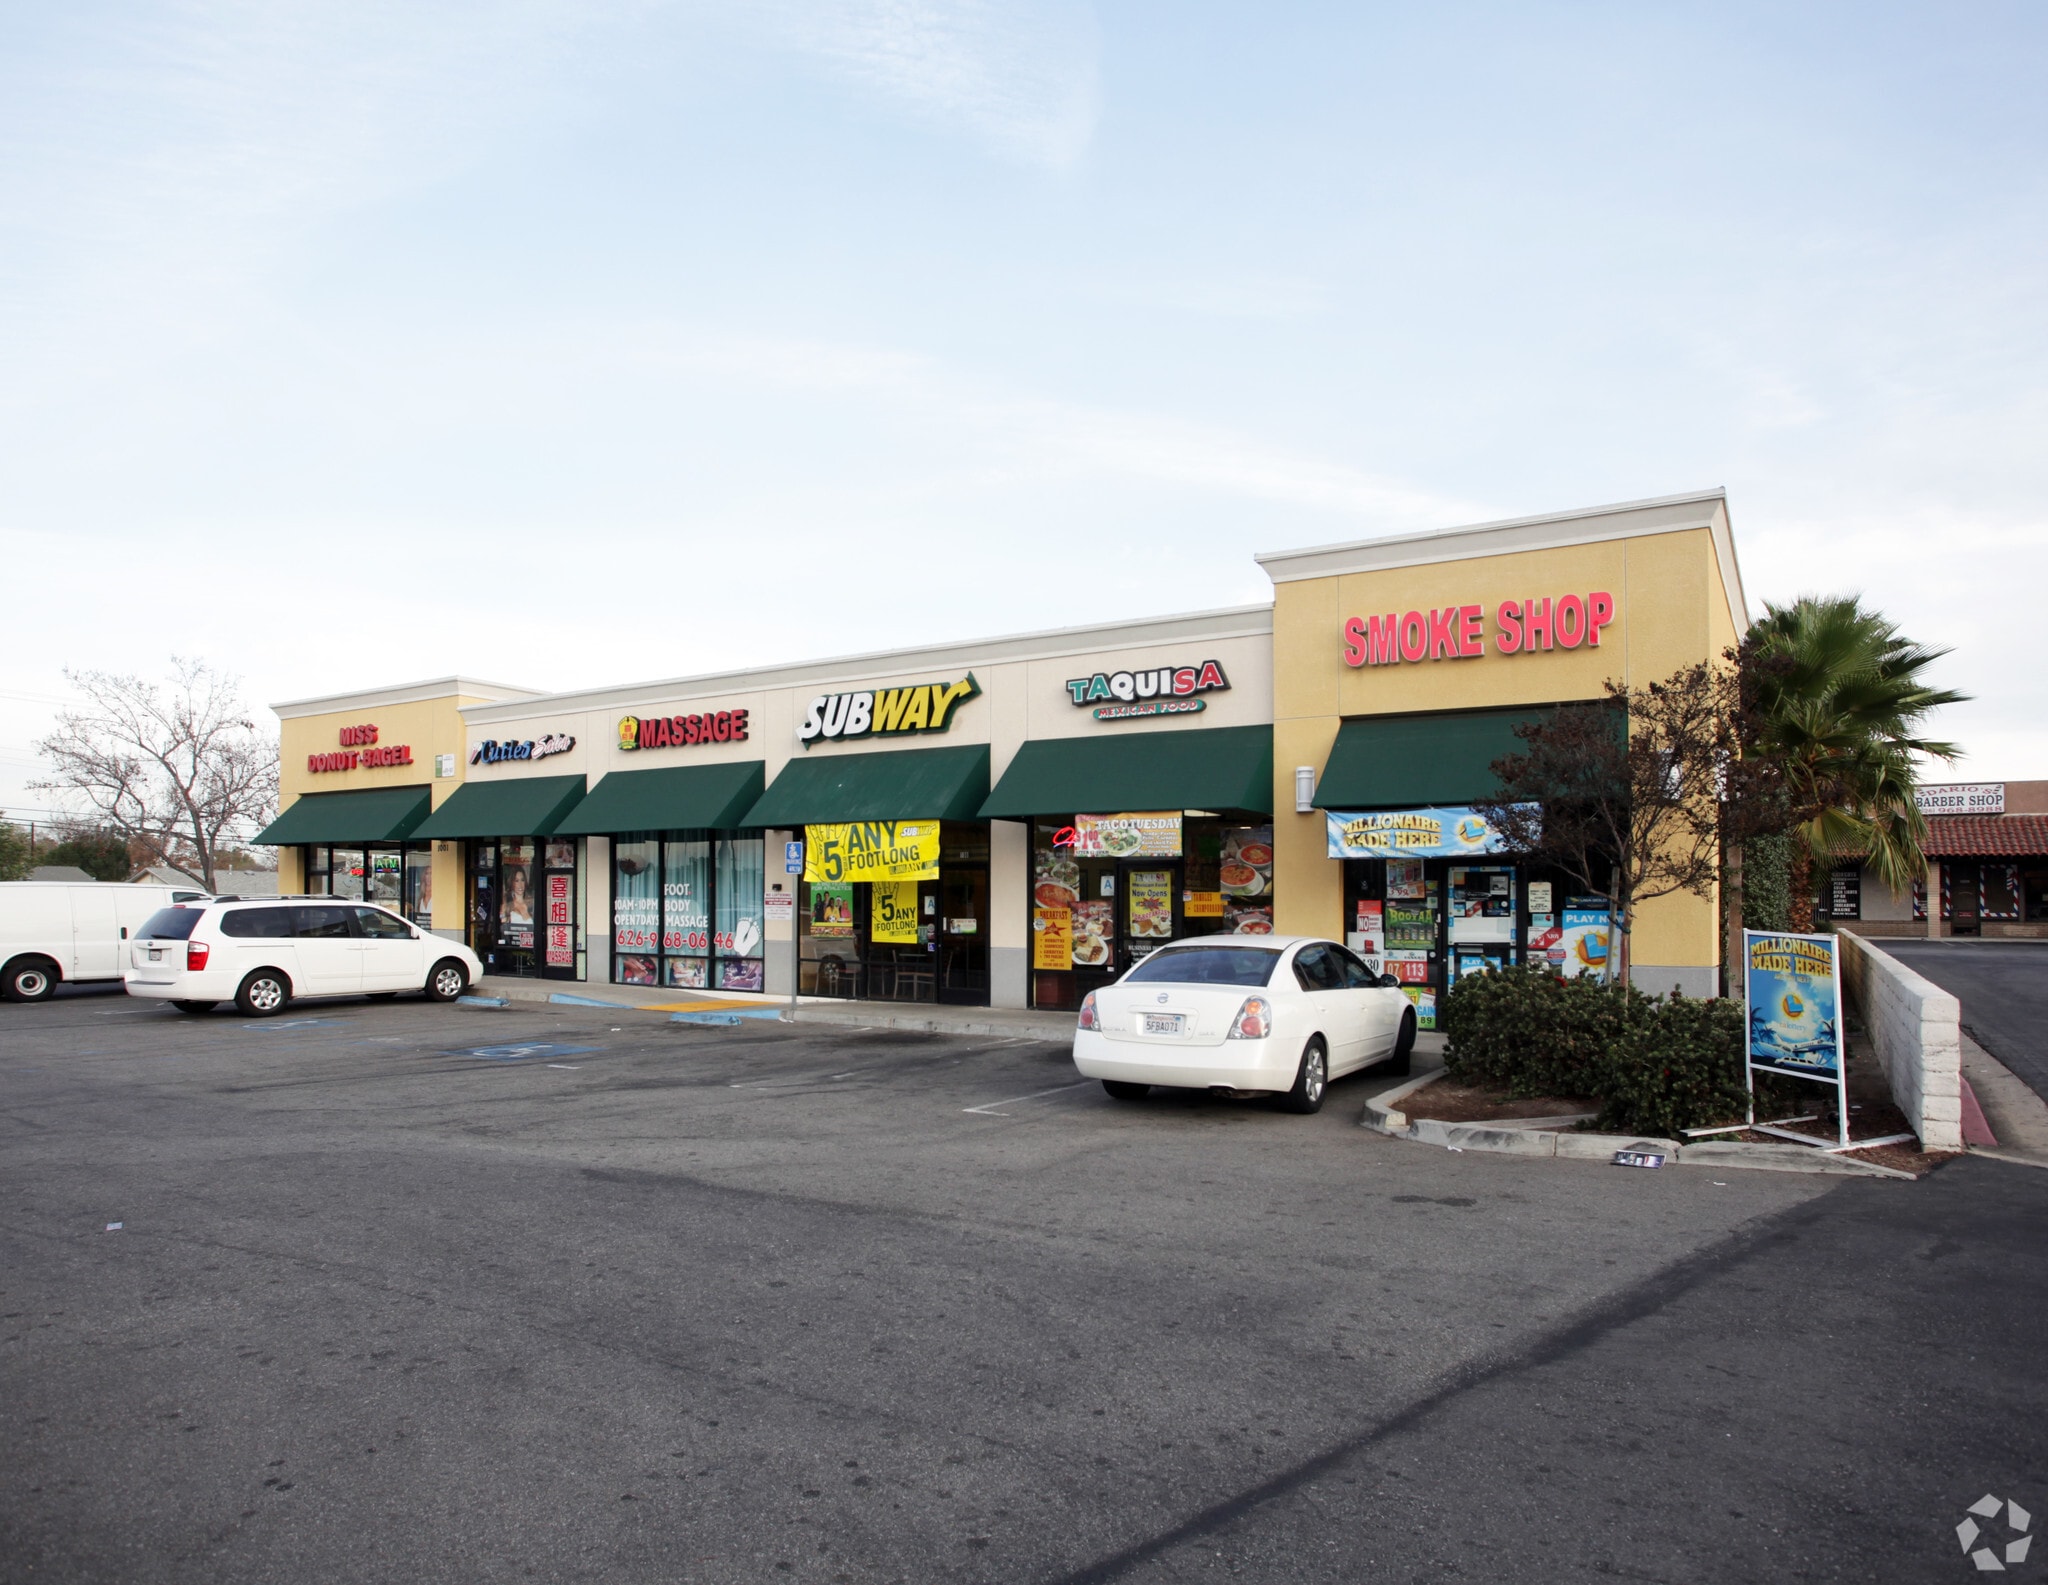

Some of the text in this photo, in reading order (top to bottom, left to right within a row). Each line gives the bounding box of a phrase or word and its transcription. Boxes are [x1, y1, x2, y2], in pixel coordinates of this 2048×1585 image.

[1343, 591, 1616, 668] SMOKE SHOP
[1067, 661, 1225, 703] TAQUISA
[795, 677, 974, 741] SUBWAY
[1098, 699, 1198, 718] MEXICAN FOOD
[339, 724, 379, 747] MISS
[640, 709, 749, 748] MASSAGE
[481, 733, 576, 764] Cuties Salon
[308, 751, 360, 773] DONUT
[362, 745, 414, 768] BAGEL
[1916, 794, 2003, 807] BARBER SHOP
[1926, 786, 1993, 797] DARIO'S
[1097, 817, 1182, 831] TACO TUESDAY
[1341, 814, 1442, 834] MILLIONAIRE
[848, 820, 896, 854] ANY
[1343, 831, 1442, 849] MADE HERE
[376, 858, 398, 869] ATM
[847, 844, 921, 871] FOOTLONG
[1104, 879, 1112, 890] A
[551, 876, 569, 949] 喜相逢
[664, 899, 691, 912] BODY
[927, 899, 935, 908] A
[664, 915, 709, 928] MASSAGE
[895, 907, 916, 921] ANY
[1566, 914, 1595, 923] PLAY
[876, 920, 916, 932] FOOTLONG
[1750, 937, 1832, 964] MILLIONAIRE
[1405, 963, 1425, 977] 113
[1751, 955, 1832, 978] MADE HERE
